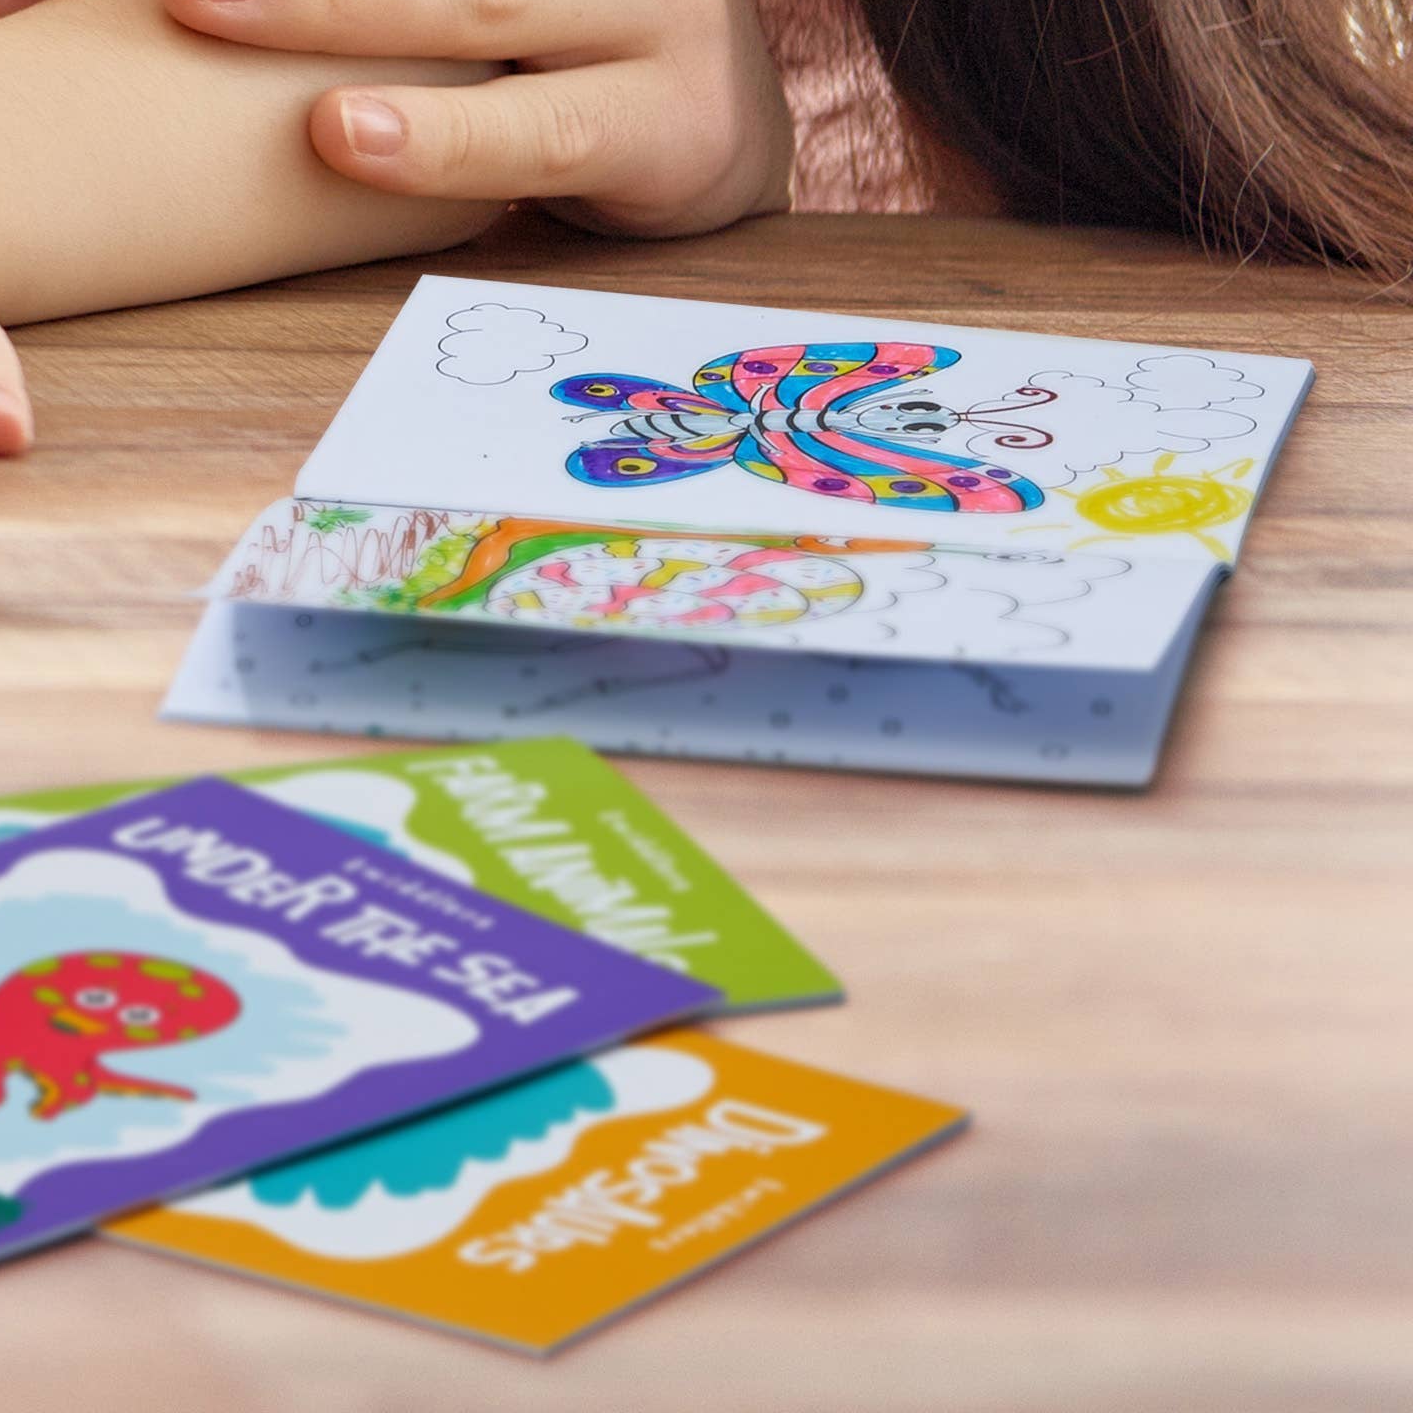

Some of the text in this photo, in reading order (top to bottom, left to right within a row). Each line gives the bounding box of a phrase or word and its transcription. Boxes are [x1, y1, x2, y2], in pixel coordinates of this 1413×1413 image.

[406, 754, 572, 843] FARM
[111, 817, 579, 1025] UNDER THE SEA
